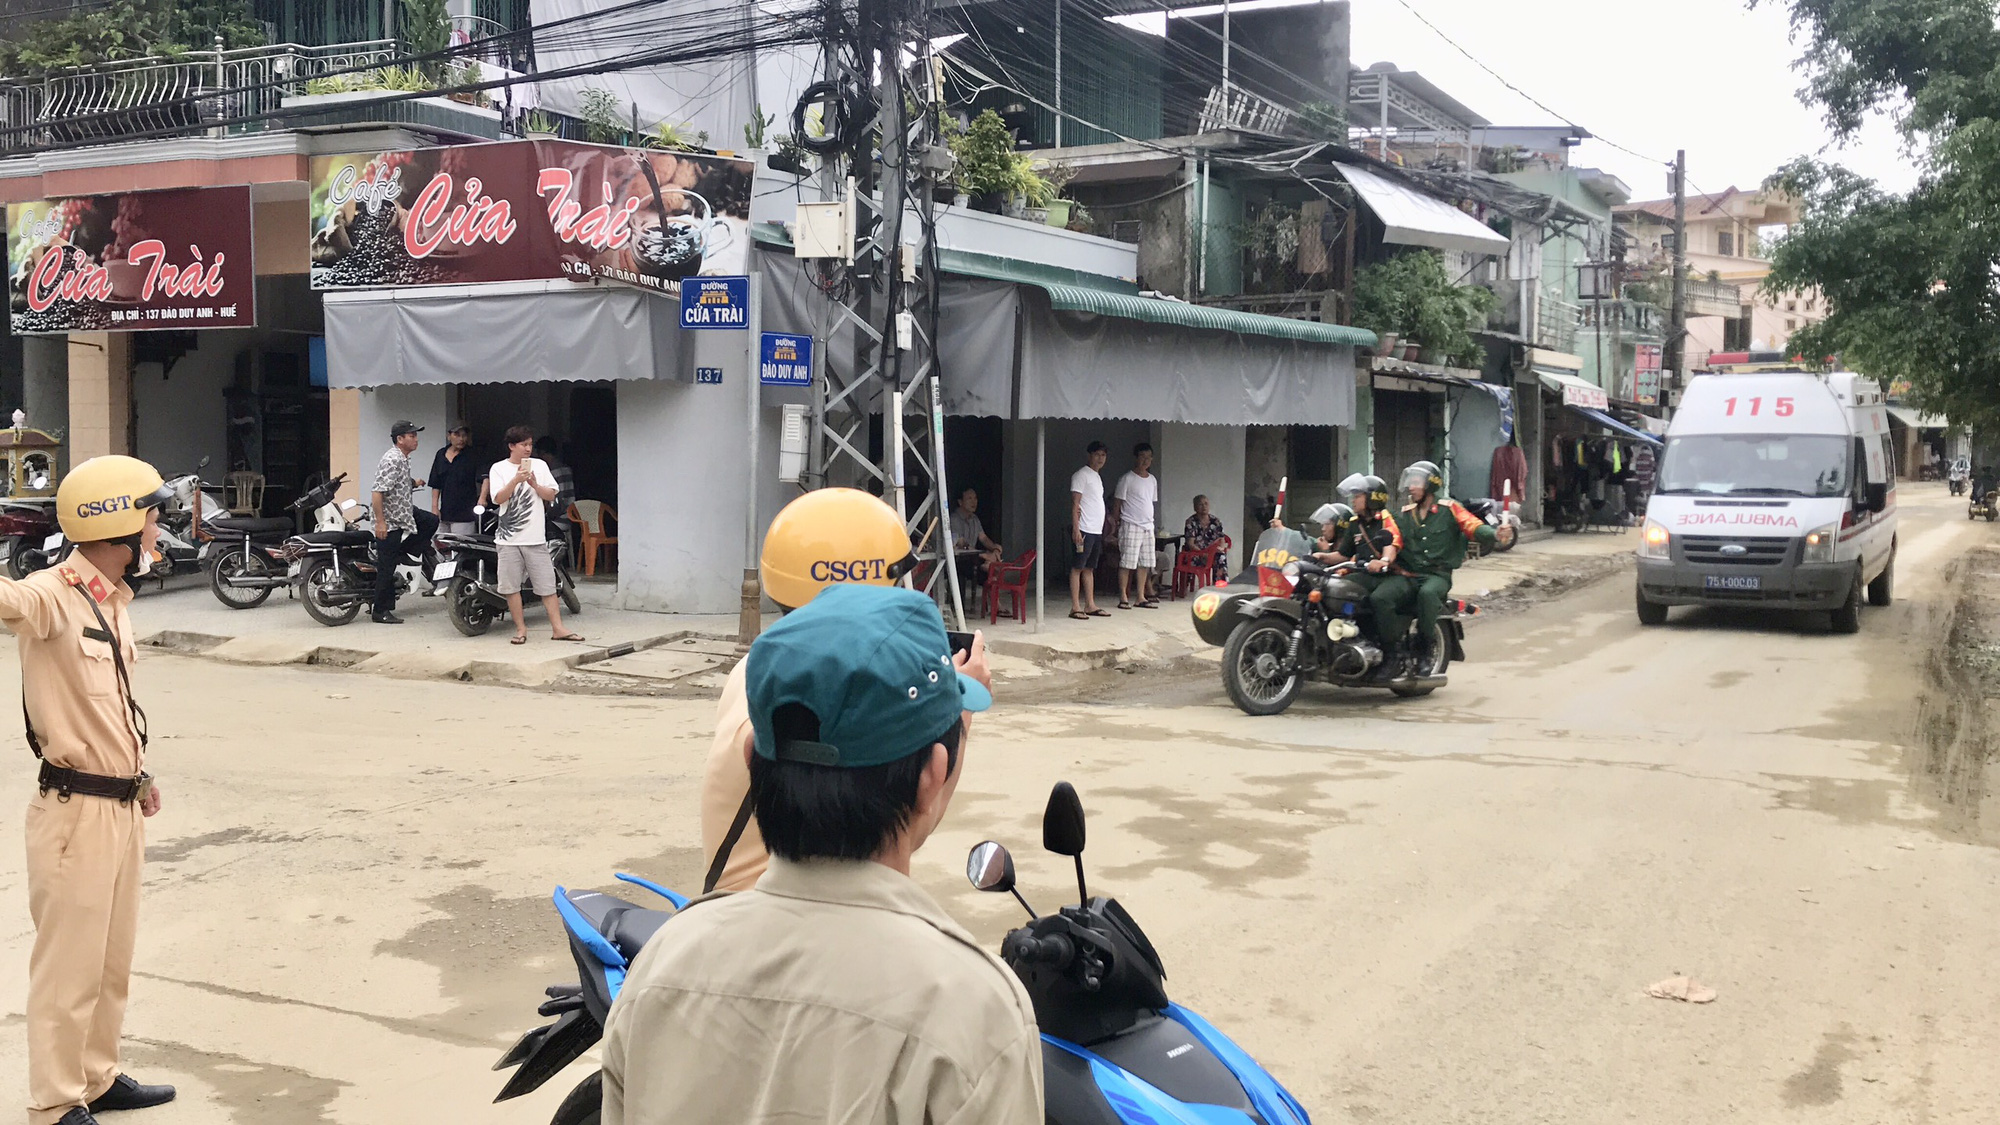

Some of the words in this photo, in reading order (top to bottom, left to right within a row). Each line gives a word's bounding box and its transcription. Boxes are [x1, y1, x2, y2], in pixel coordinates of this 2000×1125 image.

[327, 161, 403, 216] Café
[403, 173, 517, 260] Cửa
[536, 166, 641, 251] Trài
[19, 208, 63, 245] Café
[27, 248, 113, 312] Cửa
[127, 240, 225, 301] Trài
[616, 268, 638, 283] ĐÀO
[640, 273, 660, 288] DUY
[701, 281, 728, 290] ĐƯỜNG
[111, 309, 125, 322] ĐỊA
[126, 307, 139, 320] CHỈ
[145, 309, 159, 319] 137
[161, 306, 177, 319] ĐÀO
[179, 308, 194, 318] DUY
[197, 307, 213, 318] ANH
[220, 303, 237, 317] HUẾ
[685, 302, 710, 323] CỬA
[714, 304, 743, 323] TRÀI
[775, 338, 796, 347] ĐƯỜNG
[697, 369, 721, 382] 137
[762, 360, 777, 378] ĐÀO
[778, 365, 792, 380] DUY
[793, 365, 808, 380] ANH
[77, 495, 131, 518] CSGT
[810, 558, 886, 582] CSGT
